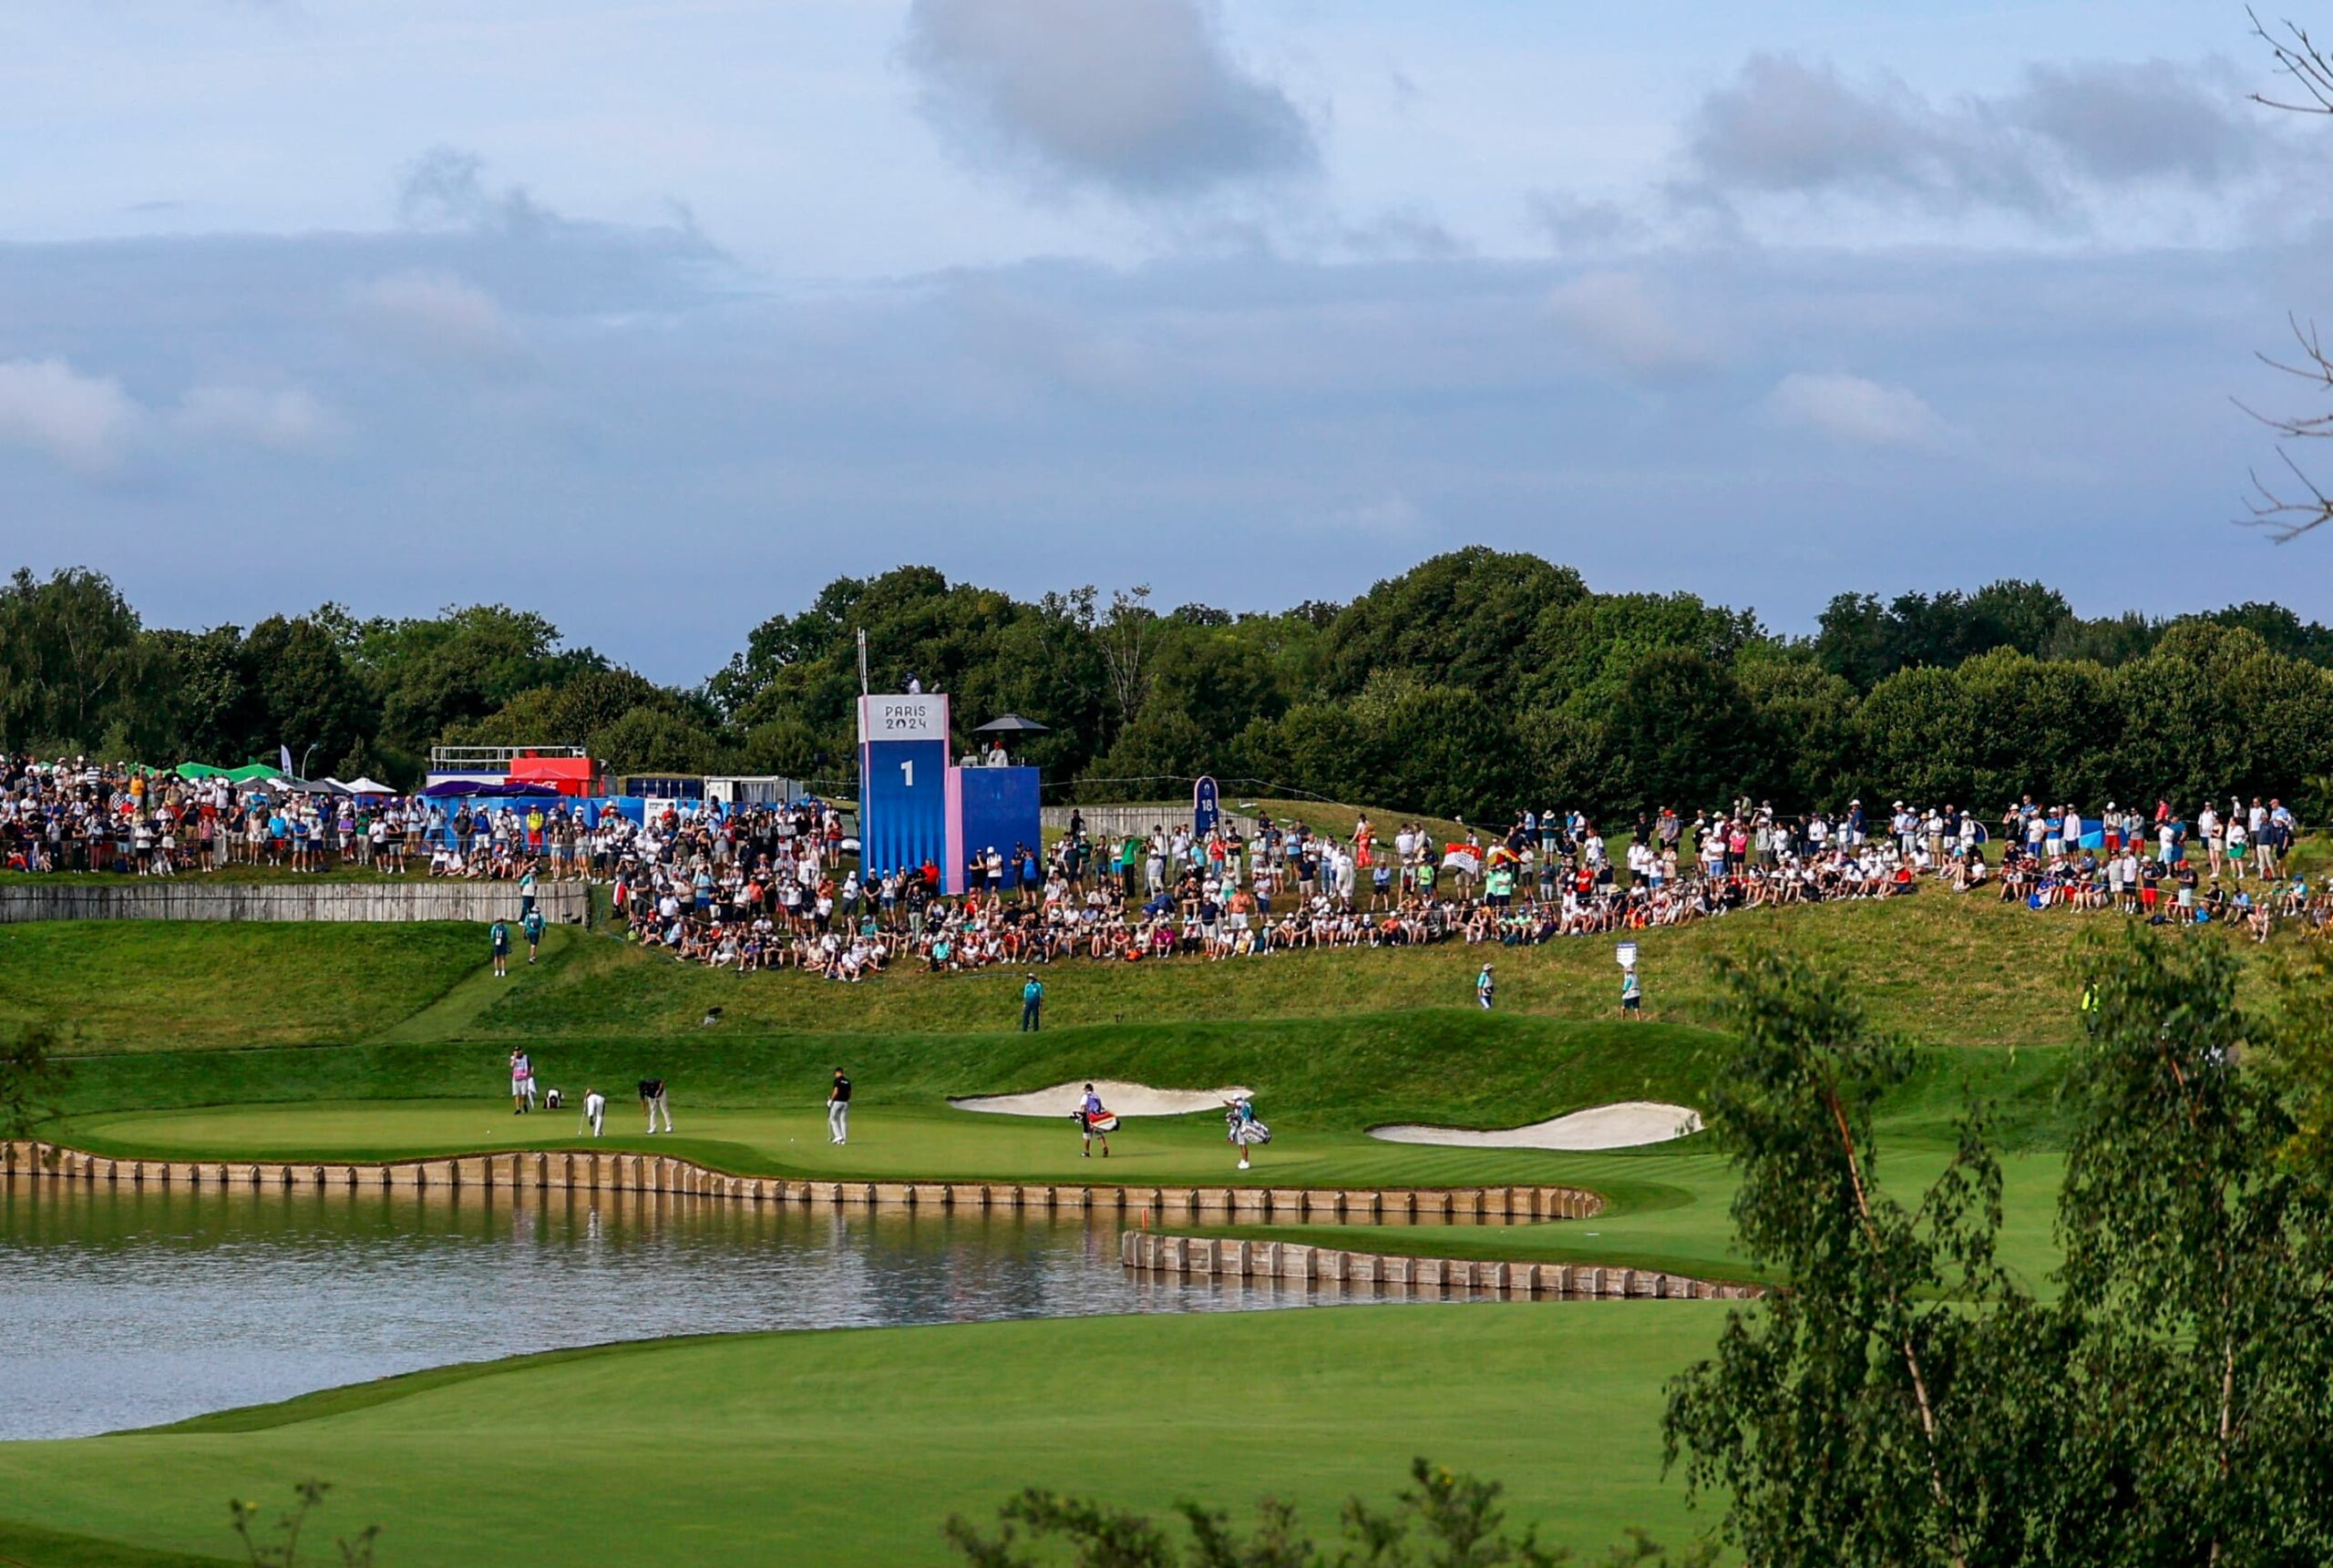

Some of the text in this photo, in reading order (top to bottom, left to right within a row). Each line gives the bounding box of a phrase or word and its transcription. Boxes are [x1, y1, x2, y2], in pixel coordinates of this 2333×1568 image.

[885, 705, 926, 717] PARIS
[886, 718, 927, 729] 2024
[900, 760, 913, 786] 1
[1201, 799, 1213, 812] 18
